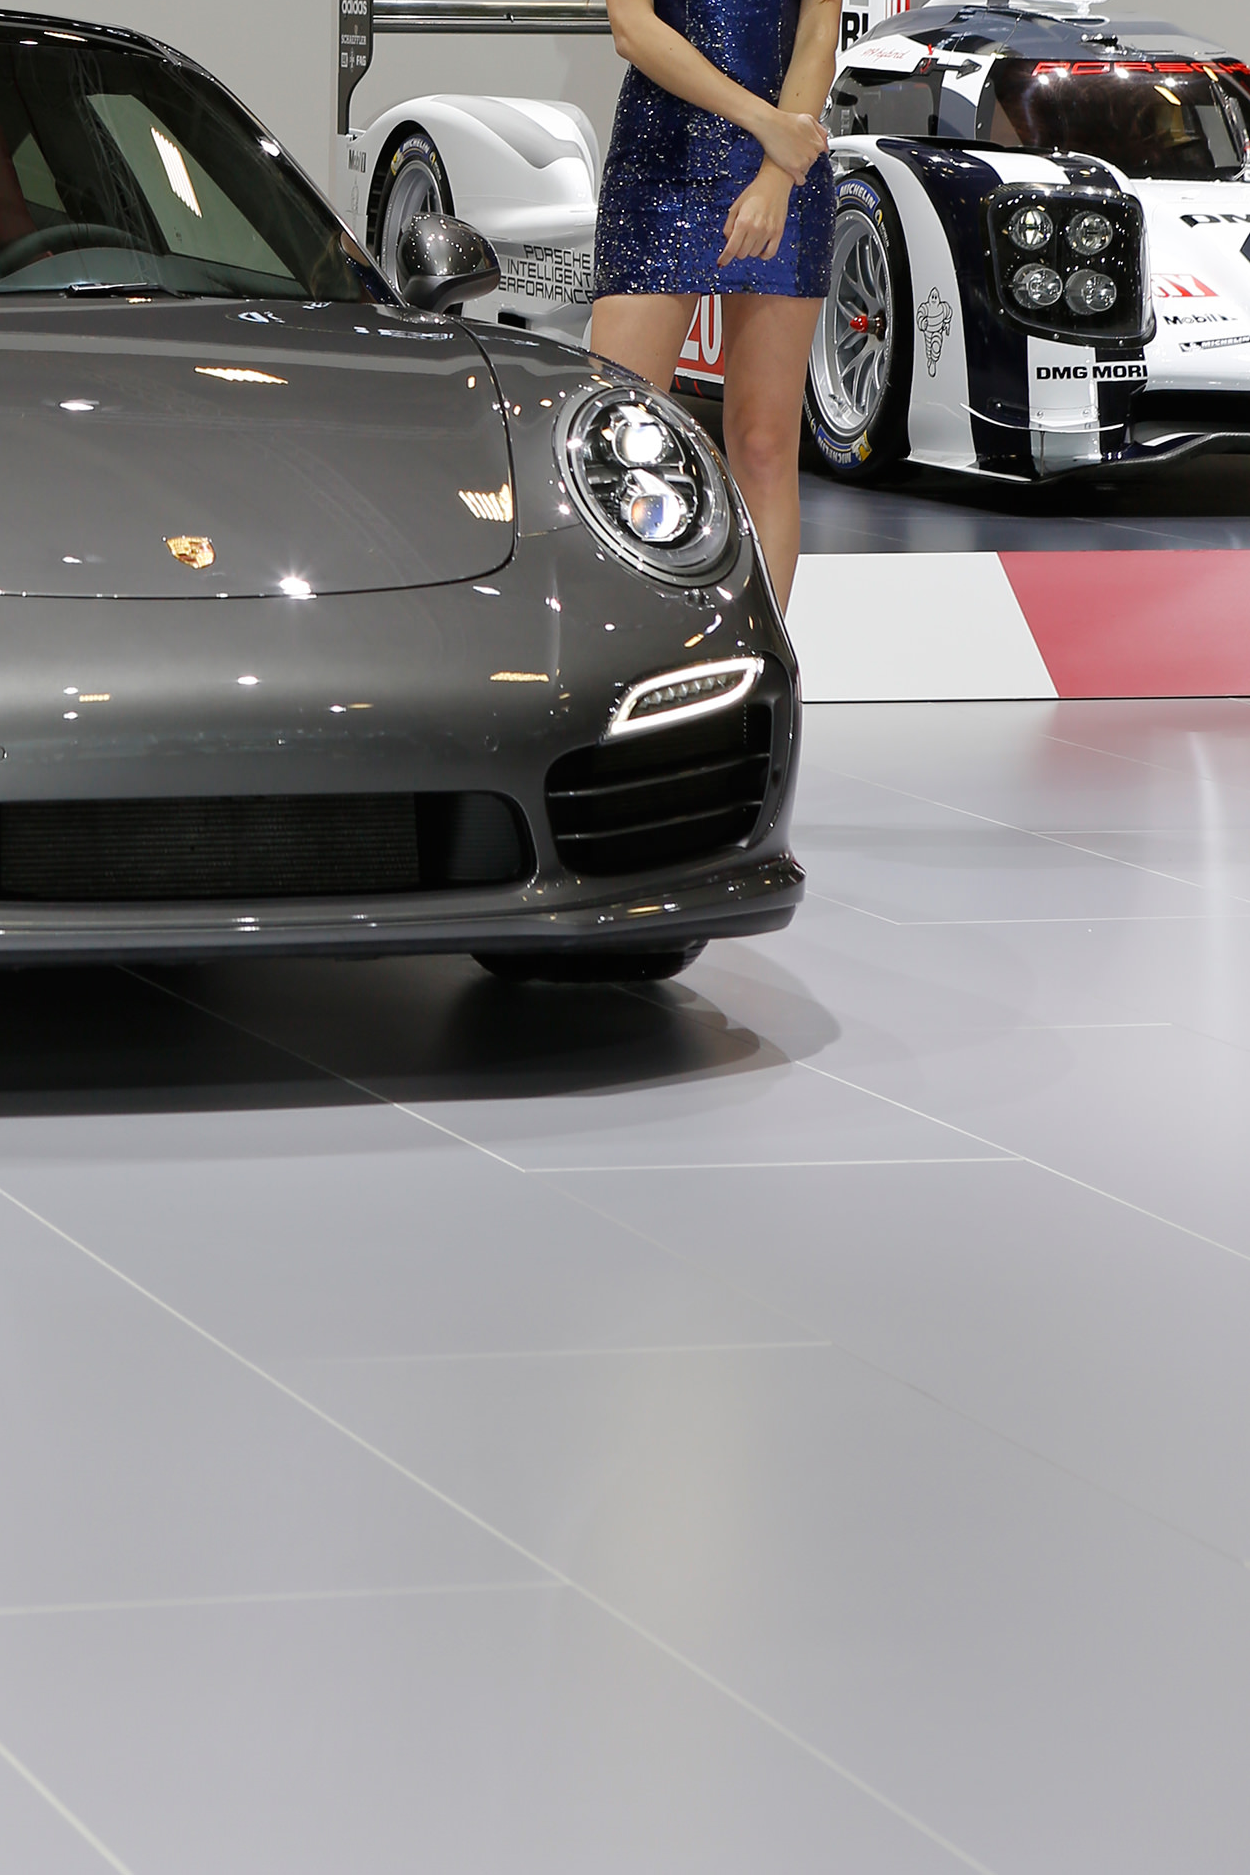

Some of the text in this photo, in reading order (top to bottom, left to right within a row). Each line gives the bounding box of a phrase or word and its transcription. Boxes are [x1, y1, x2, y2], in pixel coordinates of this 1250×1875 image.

[401, 137, 431, 154] MICHELIN
[839, 182, 876, 210] MICHELIN
[523, 244, 591, 271] PORSCHE
[507, 258, 592, 288] INTELLIGENT
[497, 275, 594, 305] ERFORMANCE
[1036, 365, 1148, 380] DMG MORI
[817, 435, 852, 464] MICHELIN
